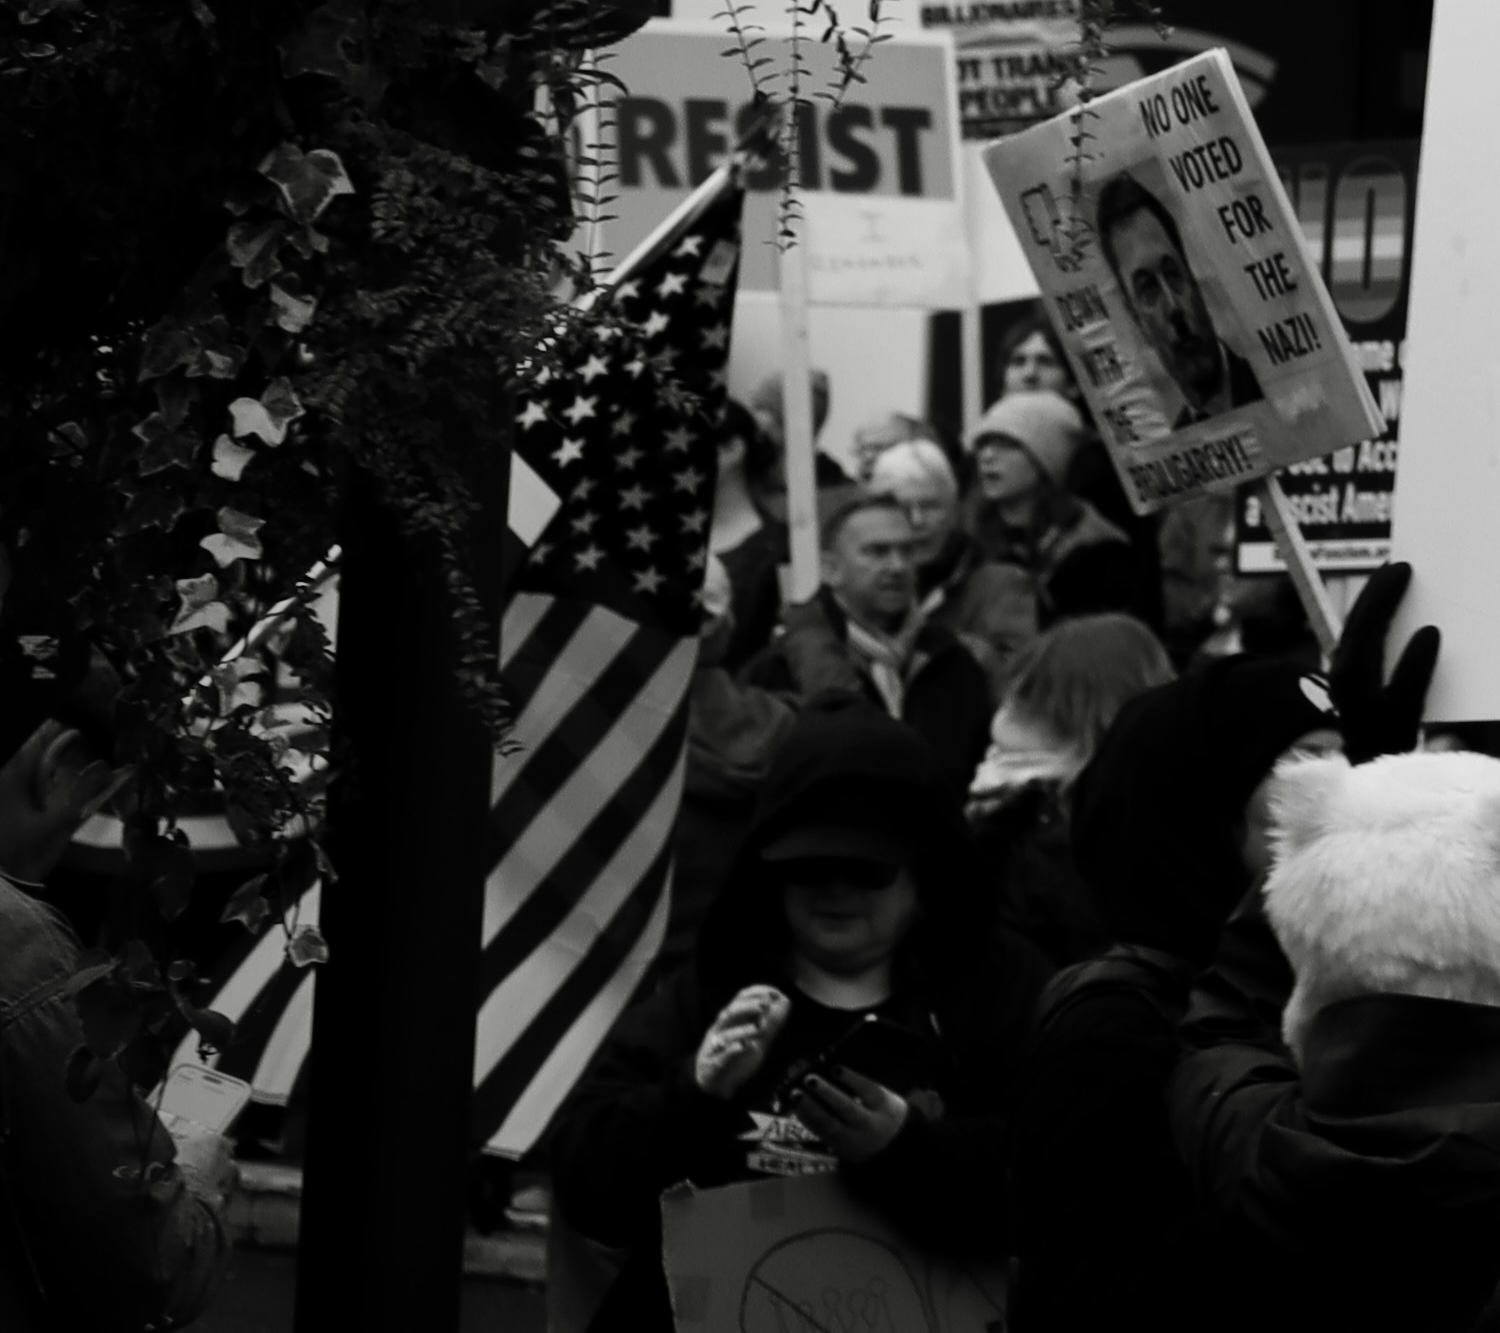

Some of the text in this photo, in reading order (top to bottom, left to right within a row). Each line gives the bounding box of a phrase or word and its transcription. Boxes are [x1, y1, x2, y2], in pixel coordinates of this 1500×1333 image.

[1140, 75, 1219, 139] NO ONE
[616, 96, 931, 197] RESIST
[1169, 135, 1243, 193] VOTED
[1217, 195, 1272, 244] FOR
[1243, 252, 1297, 302] THE
[1257, 311, 1322, 365] NAZI!
[1342, 481, 1394, 523] Ame
